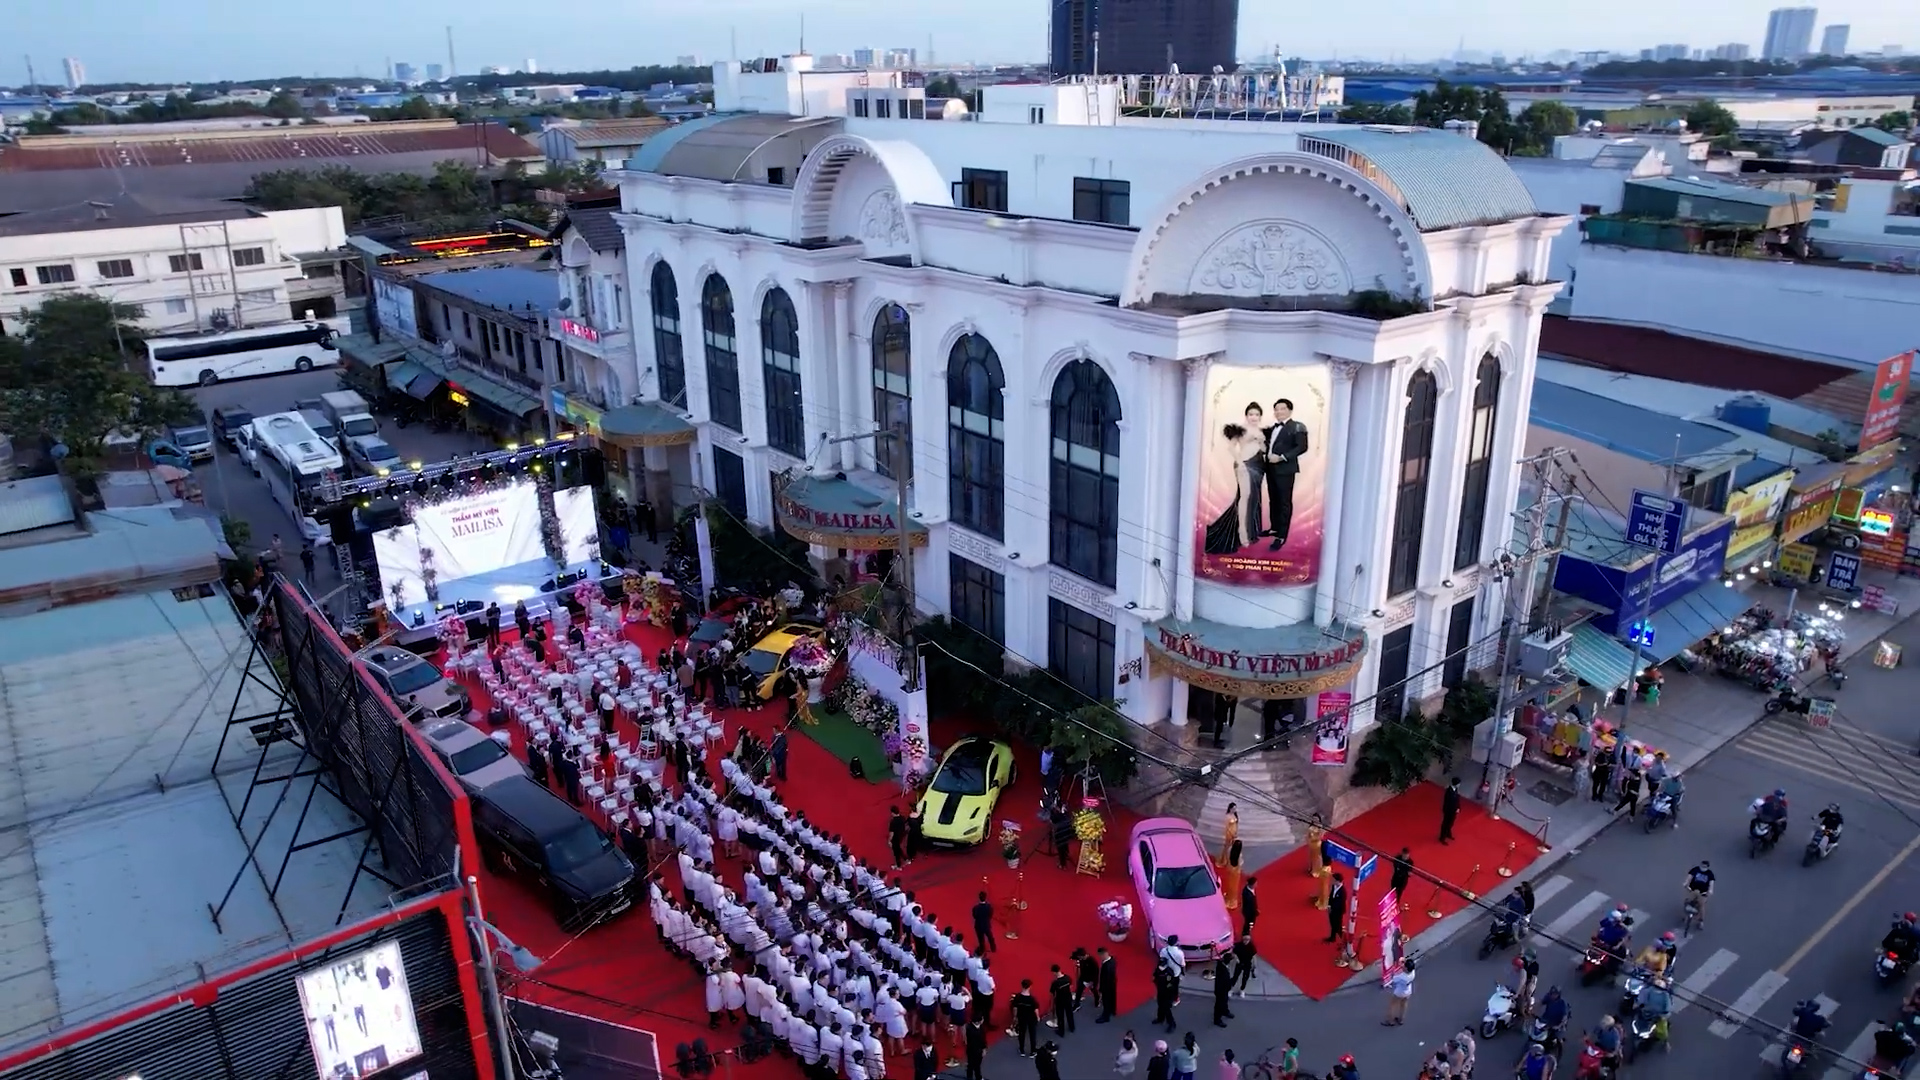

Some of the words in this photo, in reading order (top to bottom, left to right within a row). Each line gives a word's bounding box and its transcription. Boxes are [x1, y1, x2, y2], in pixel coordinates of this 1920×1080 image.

[452, 516, 504, 538] MAILISA
[815, 510, 896, 530] MAILISA
[1246, 653, 1302, 674] VIỆN
[1809, 714, 1830, 728] 100K
